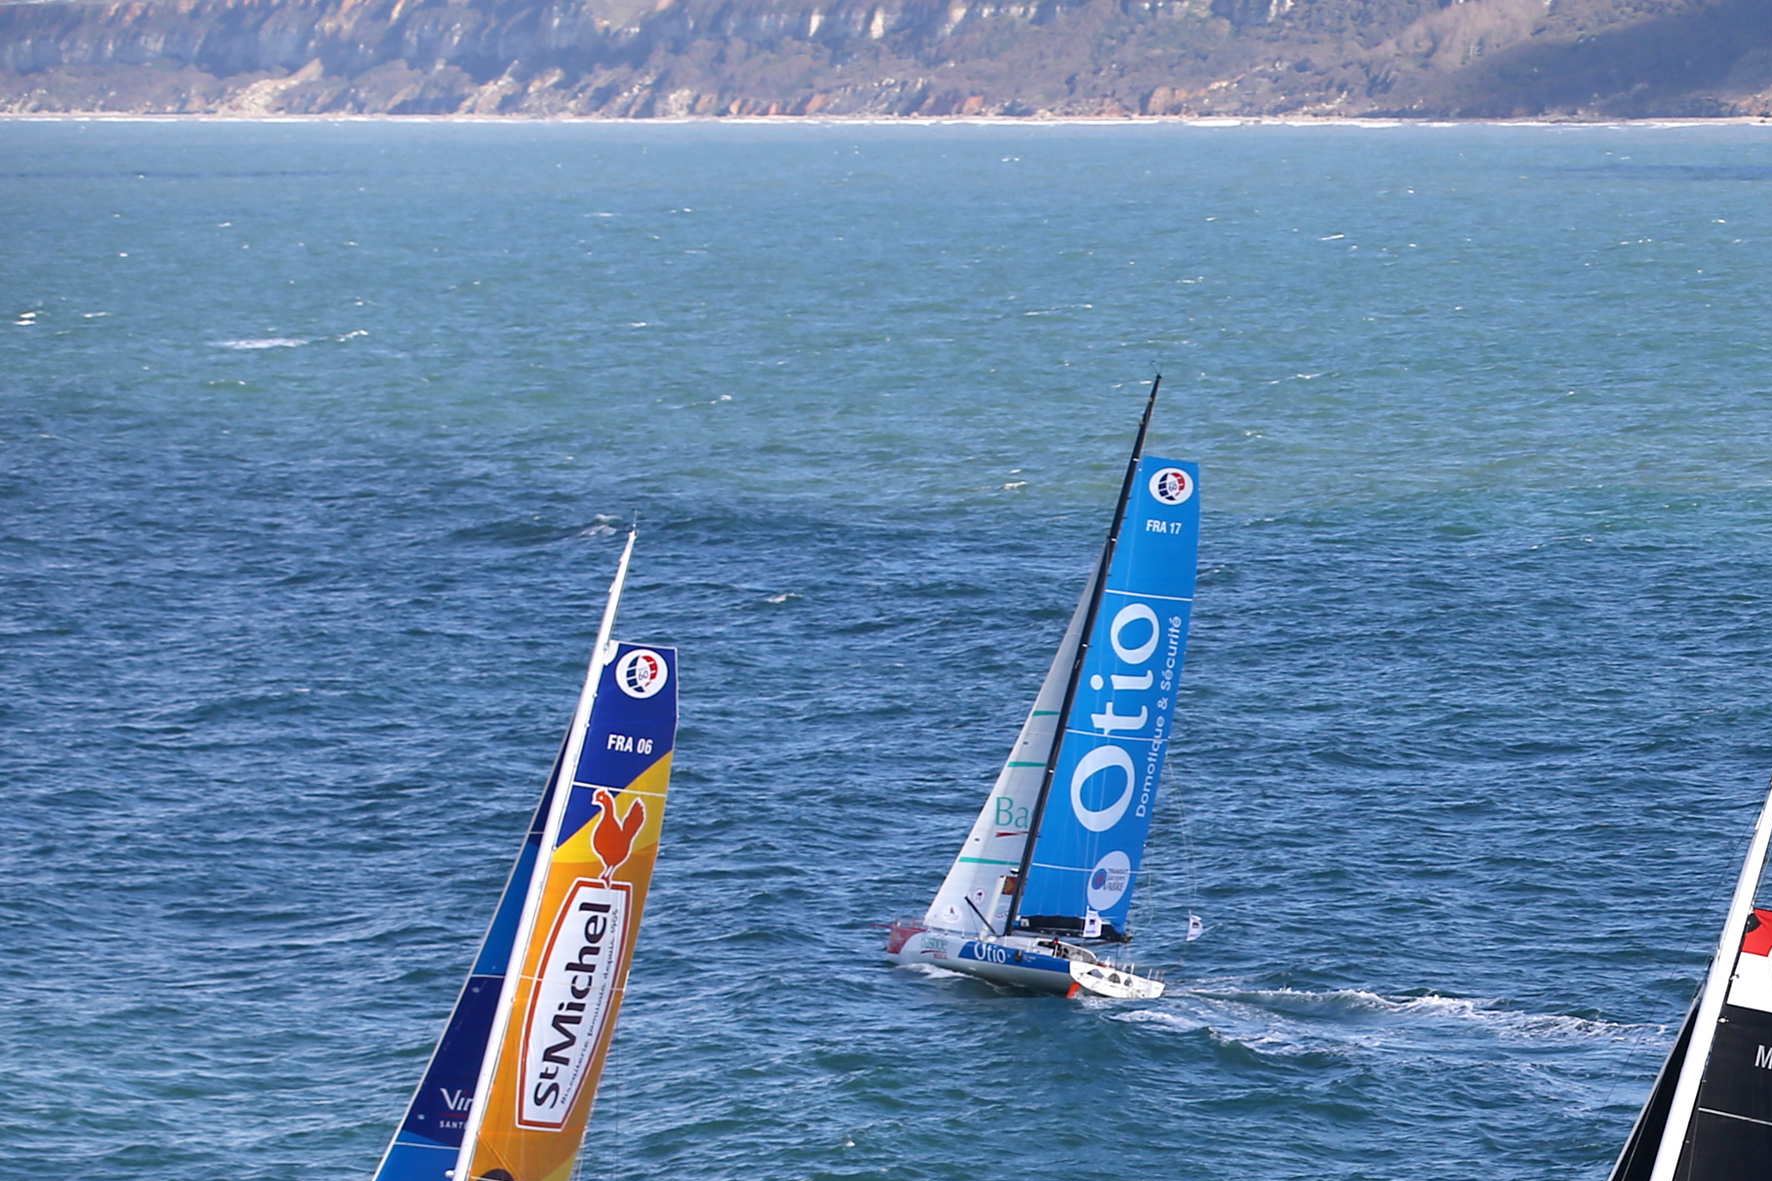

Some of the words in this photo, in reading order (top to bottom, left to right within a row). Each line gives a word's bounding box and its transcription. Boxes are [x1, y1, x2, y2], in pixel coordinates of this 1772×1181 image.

[1146, 519, 1167, 534] FRA
[1169, 521, 1183, 535] 17
[1160, 615, 1182, 692] Sécurité
[1157, 696, 1169, 711] &
[1070, 603, 1160, 833] Otio
[606, 733, 634, 753] FRA
[636, 737, 654, 755] 06
[1135, 715, 1166, 818] Domotique
[994, 796, 1035, 829] Ba
[973, 940, 1007, 964] Otio
[440, 1087, 474, 1111] Vir
[439, 1120, 466, 1129] SANT
